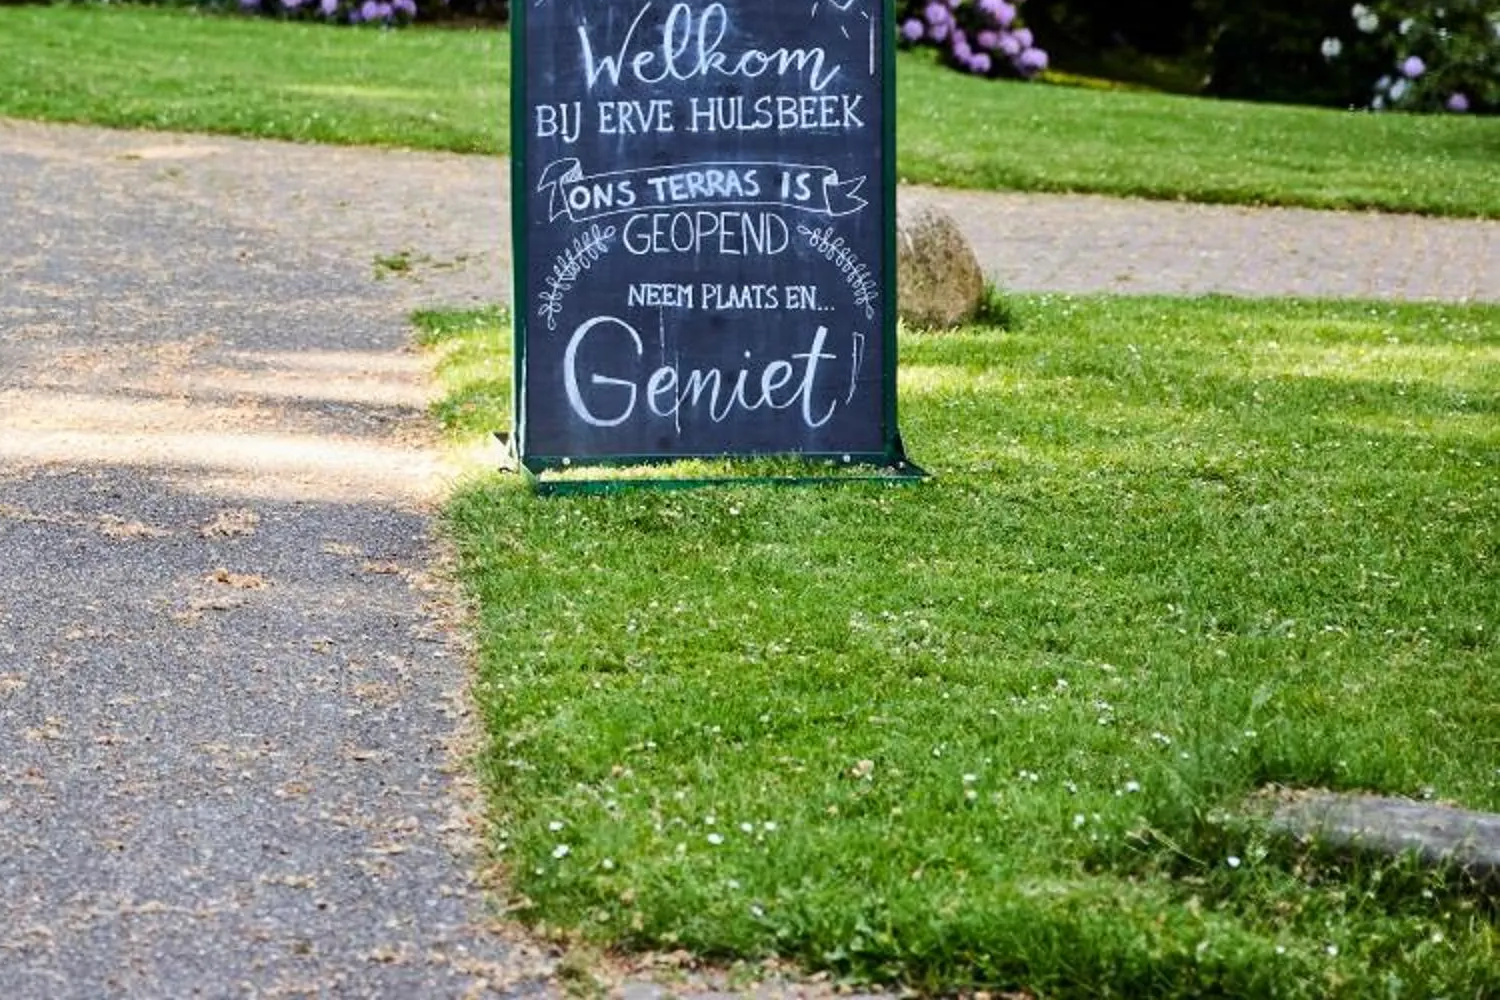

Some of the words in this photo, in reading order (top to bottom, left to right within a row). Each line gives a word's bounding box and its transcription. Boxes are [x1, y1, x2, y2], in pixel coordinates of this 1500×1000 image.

[577, 1, 841, 92] Welkom
[536, 101, 581, 142] BIJ
[598, 99, 674, 134] ERVE
[688, 95, 865, 133] HULSBEEK
[569, 181, 637, 209] ONS
[648, 169, 761, 202] TERRAS
[781, 170, 812, 201] IS
[622, 210, 789, 256] GEOPEND
[627, 283, 694, 309] NEEM
[701, 283, 779, 310] PLAATS
